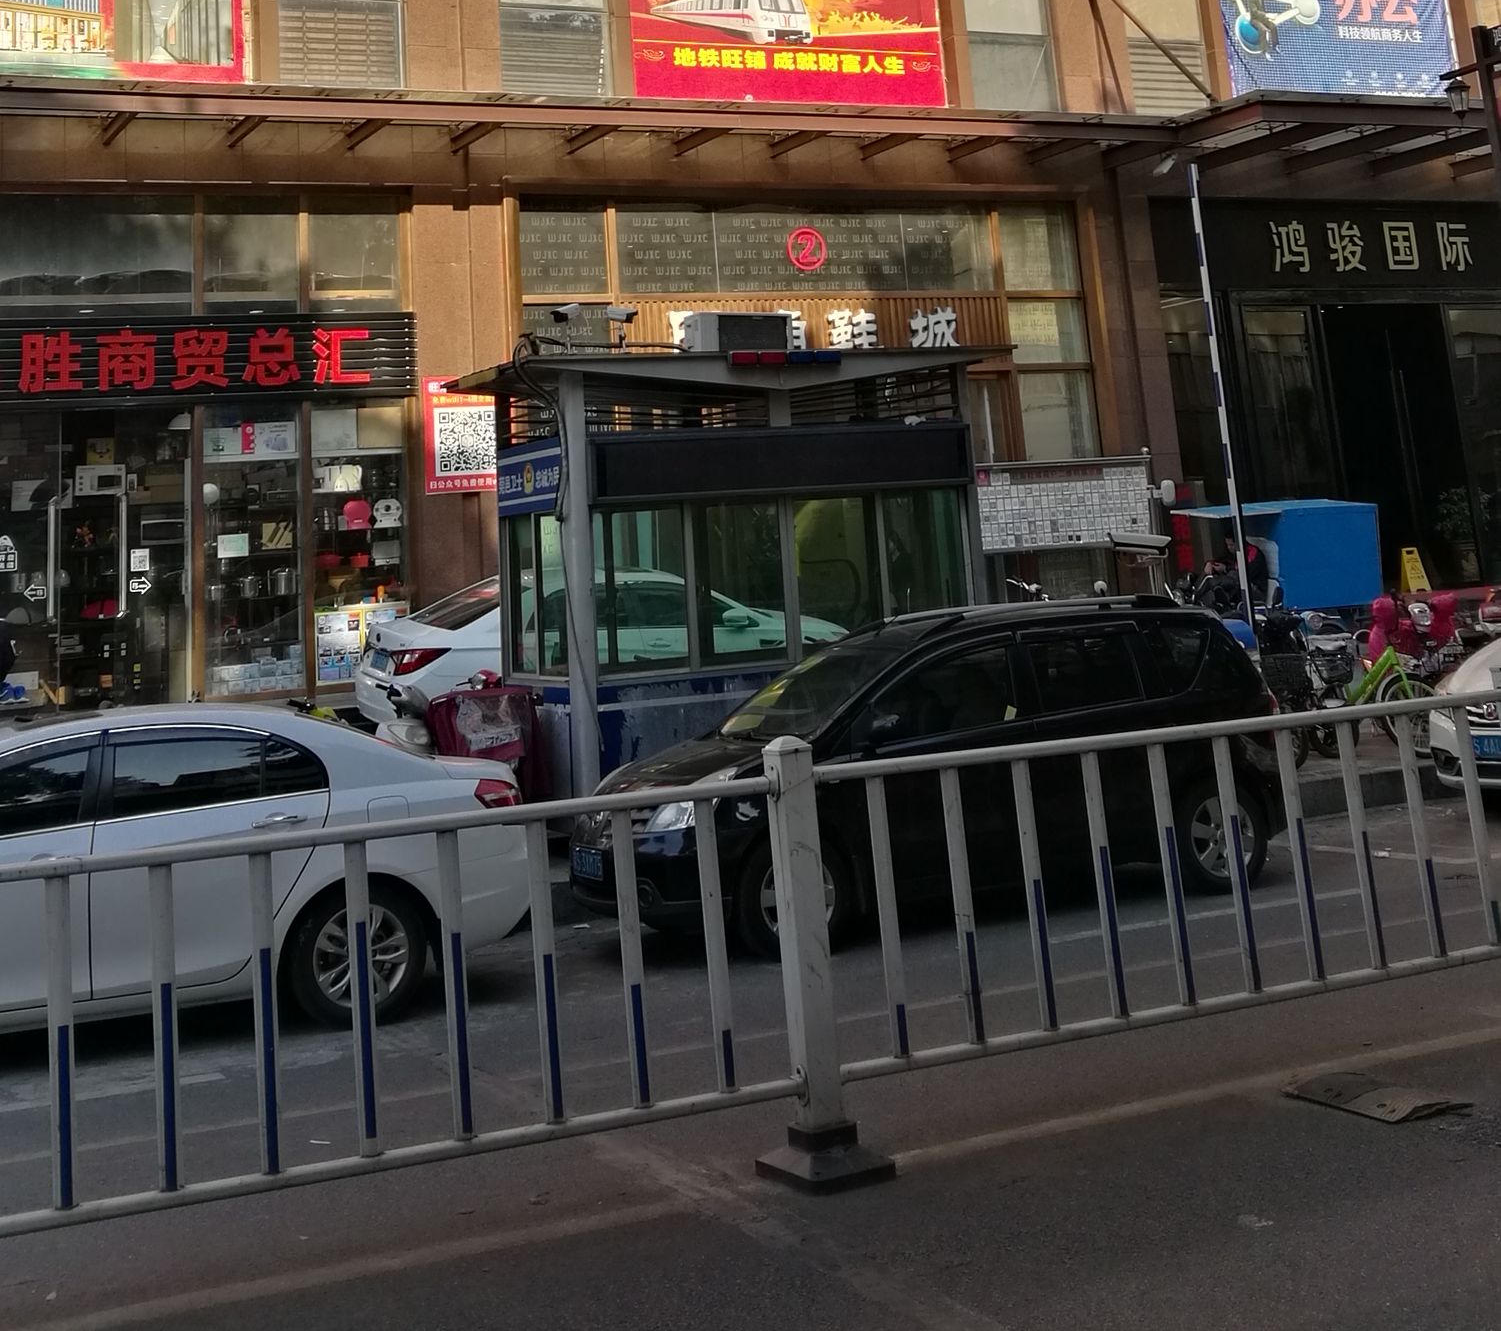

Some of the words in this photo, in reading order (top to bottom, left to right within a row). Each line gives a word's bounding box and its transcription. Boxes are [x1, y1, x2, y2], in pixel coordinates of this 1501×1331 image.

[1338, 24, 1423, 43] 科技领航商务人生
[672, 46, 767, 71] 地铁旺铺
[773, 52, 906, 76] 成就财富人生
[1269, 220, 1473, 273] 鸿骏国际
[18, 326, 372, 394] 胜商贸总汇
